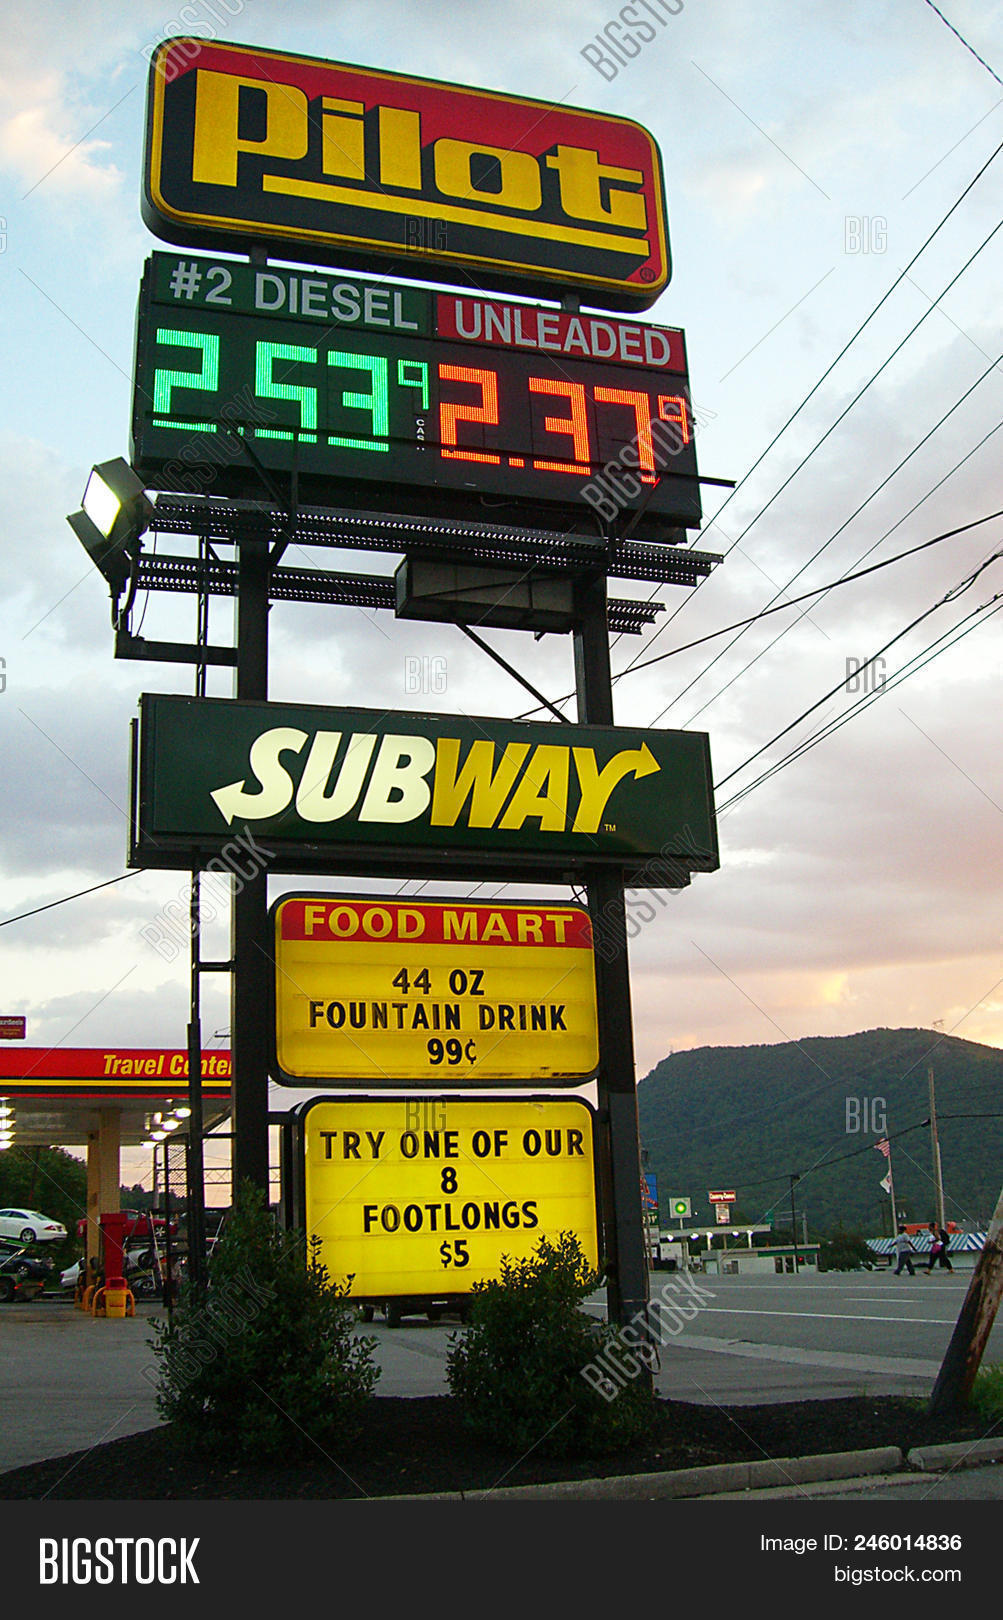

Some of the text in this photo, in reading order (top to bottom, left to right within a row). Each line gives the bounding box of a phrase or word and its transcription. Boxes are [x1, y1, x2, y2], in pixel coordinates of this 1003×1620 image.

[192, 68, 648, 231] Pilot
[170, 260, 418, 331] #2 DIESEL
[455, 302, 671, 366] UNLEADED
[210, 727, 662, 833] SUBWAY
[304, 905, 573, 943] FOOD MART
[392, 968, 485, 996] 44 OZ
[309, 1000, 567, 1031] FOUNTAIN DRINK
[103, 1054, 165, 1075] Travel
[320, 1128, 584, 1159] TRY ONE OF OUR
[440, 1167, 459, 1194] 8
[363, 1201, 539, 1233] FOOTLONGS
[440, 1239, 470, 1269] $5
